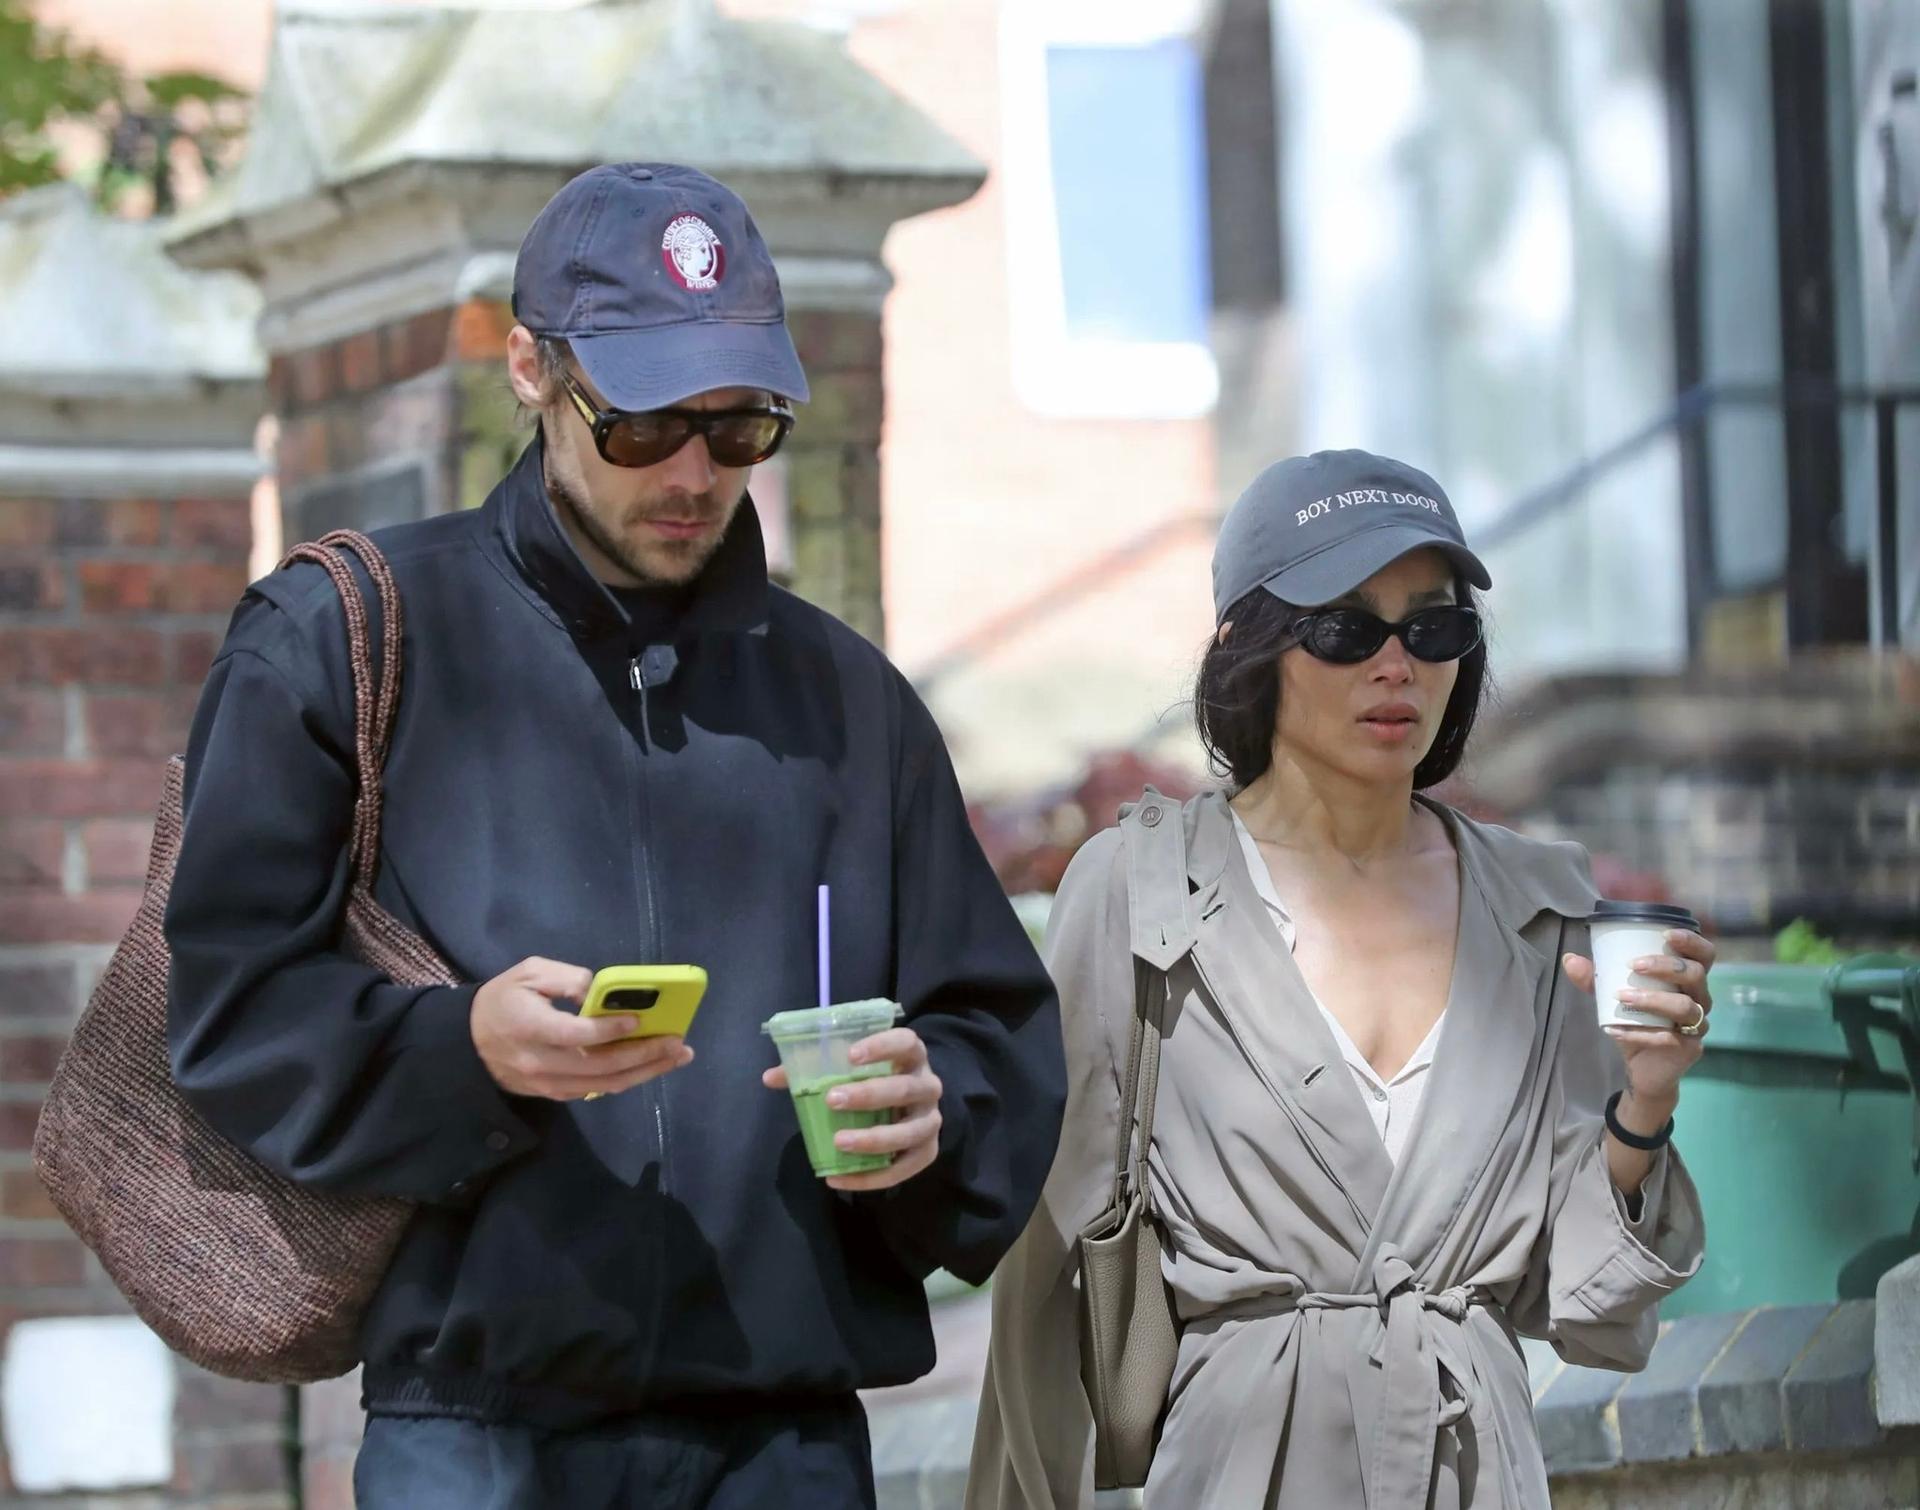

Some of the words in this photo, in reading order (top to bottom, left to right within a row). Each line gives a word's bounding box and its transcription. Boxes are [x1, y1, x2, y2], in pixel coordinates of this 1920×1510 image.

[1295, 497, 1332, 526] BOY
[1336, 489, 1389, 509] NEXT
[1391, 492, 1442, 516] DOOR
